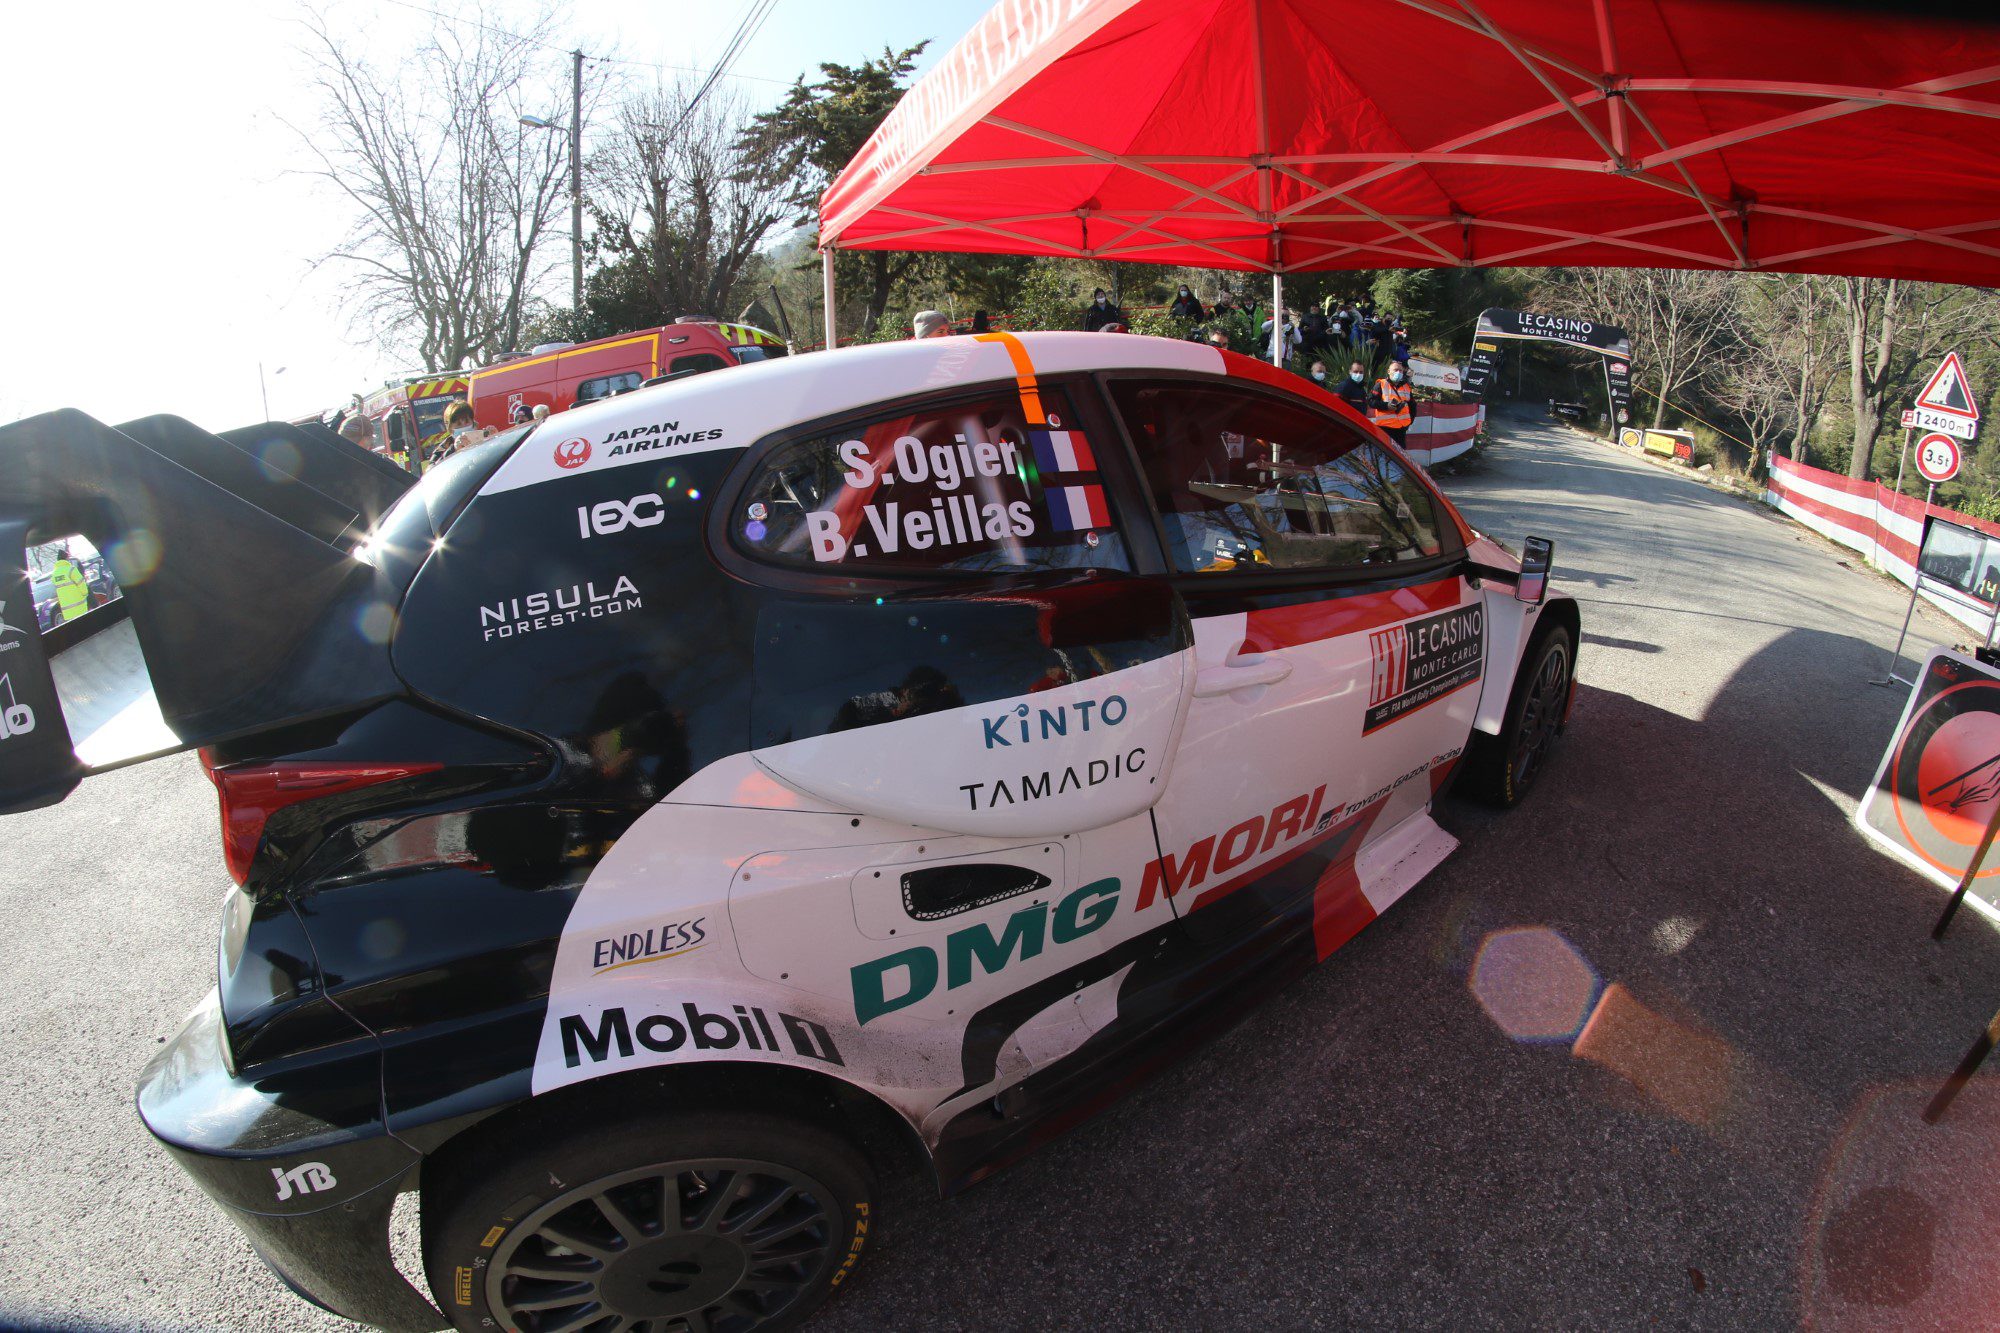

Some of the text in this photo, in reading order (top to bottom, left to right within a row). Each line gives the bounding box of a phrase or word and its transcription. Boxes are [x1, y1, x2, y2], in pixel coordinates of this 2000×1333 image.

[1518, 312, 1593, 334] LE CASINO
[602, 421, 679, 444] JAPAN
[608, 428, 724, 458] AIRLINES
[564, 457, 585, 467] JAL
[839, 432, 1017, 491] S.Ogier
[806, 493, 1036, 563] B.Veillas
[480, 575, 640, 627] NISULA
[1410, 610, 1482, 660] LE CASINO
[959, 747, 1146, 811] TAMADIC
[1345, 784, 1391, 817] TOYOTA
[1392, 762, 1430, 789] GAZOO
[850, 783, 1327, 1028] DMG MORI
[593, 917, 706, 968] ENDLESS
[559, 1002, 781, 1069] Mobil
[455, 1266, 473, 1306] PIRELLI
